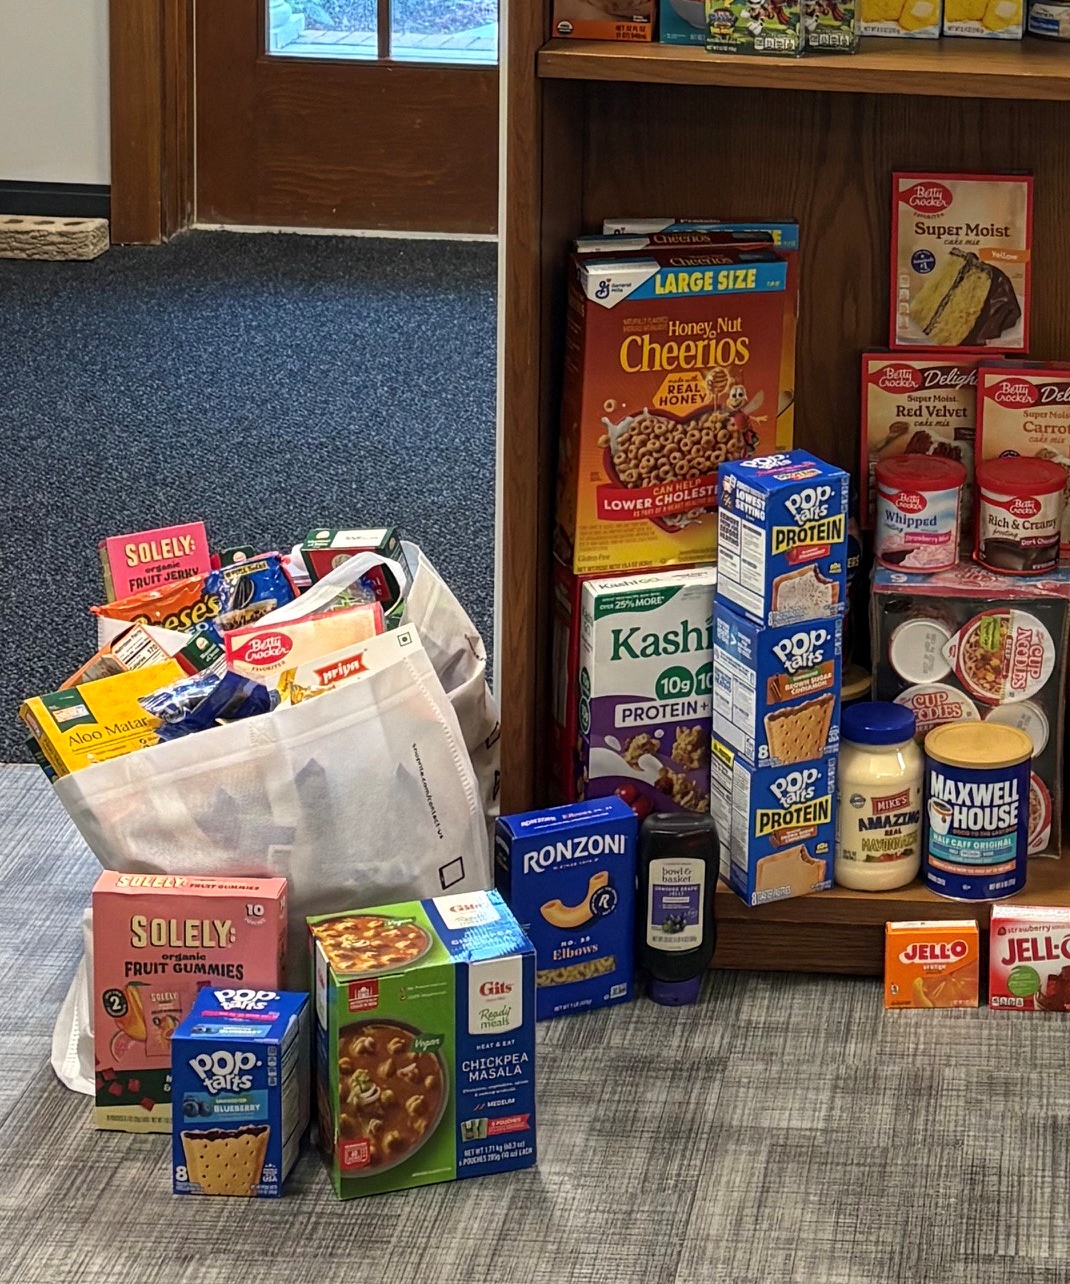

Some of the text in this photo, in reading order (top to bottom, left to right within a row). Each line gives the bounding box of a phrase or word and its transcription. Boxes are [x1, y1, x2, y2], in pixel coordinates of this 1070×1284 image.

[916, 186, 943, 199] Betty
[909, 197, 948, 207] Crocker
[914, 222, 1010, 239] Super Moist
[654, 269, 756, 295] LARGE SIZE
[668, 317, 743, 337] Honey Nut
[620, 330, 750, 373] Cheerios
[667, 383, 701, 397] REAL
[659, 393, 707, 407] HONEY
[896, 405, 968, 418] Red Velvet
[604, 498, 652, 511] LOWER
[885, 510, 937, 528] Whipped
[988, 515, 1057, 532] Rich & Creamy
[776, 519, 842, 550] PROTEIN
[129, 567, 199, 592] FRUIT JERKY
[250, 636, 281, 651] Betty
[245, 646, 289, 664] Crocker
[661, 676, 691, 694] 10g
[68, 715, 148, 747] Aloo Matar
[931, 770, 1019, 800] MAXWELL
[877, 796, 908, 811] MIKE'S
[952, 801, 1019, 829] HOUSE
[933, 834, 1011, 848] HALF CAFF ORIGINAL
[523, 834, 626, 874] RONZONI
[1007, 924, 1051, 934] strawberry
[162, 952, 206, 962] organic
[552, 943, 599, 961] Elbows
[124, 961, 244, 980] FRUIT GUMMIES
[479, 981, 512, 997] Gits
[462, 1052, 529, 1072] CHICKPEA
[469, 1065, 522, 1083] MASALA
[213, 1102, 261, 1113] BLUEBERRY
